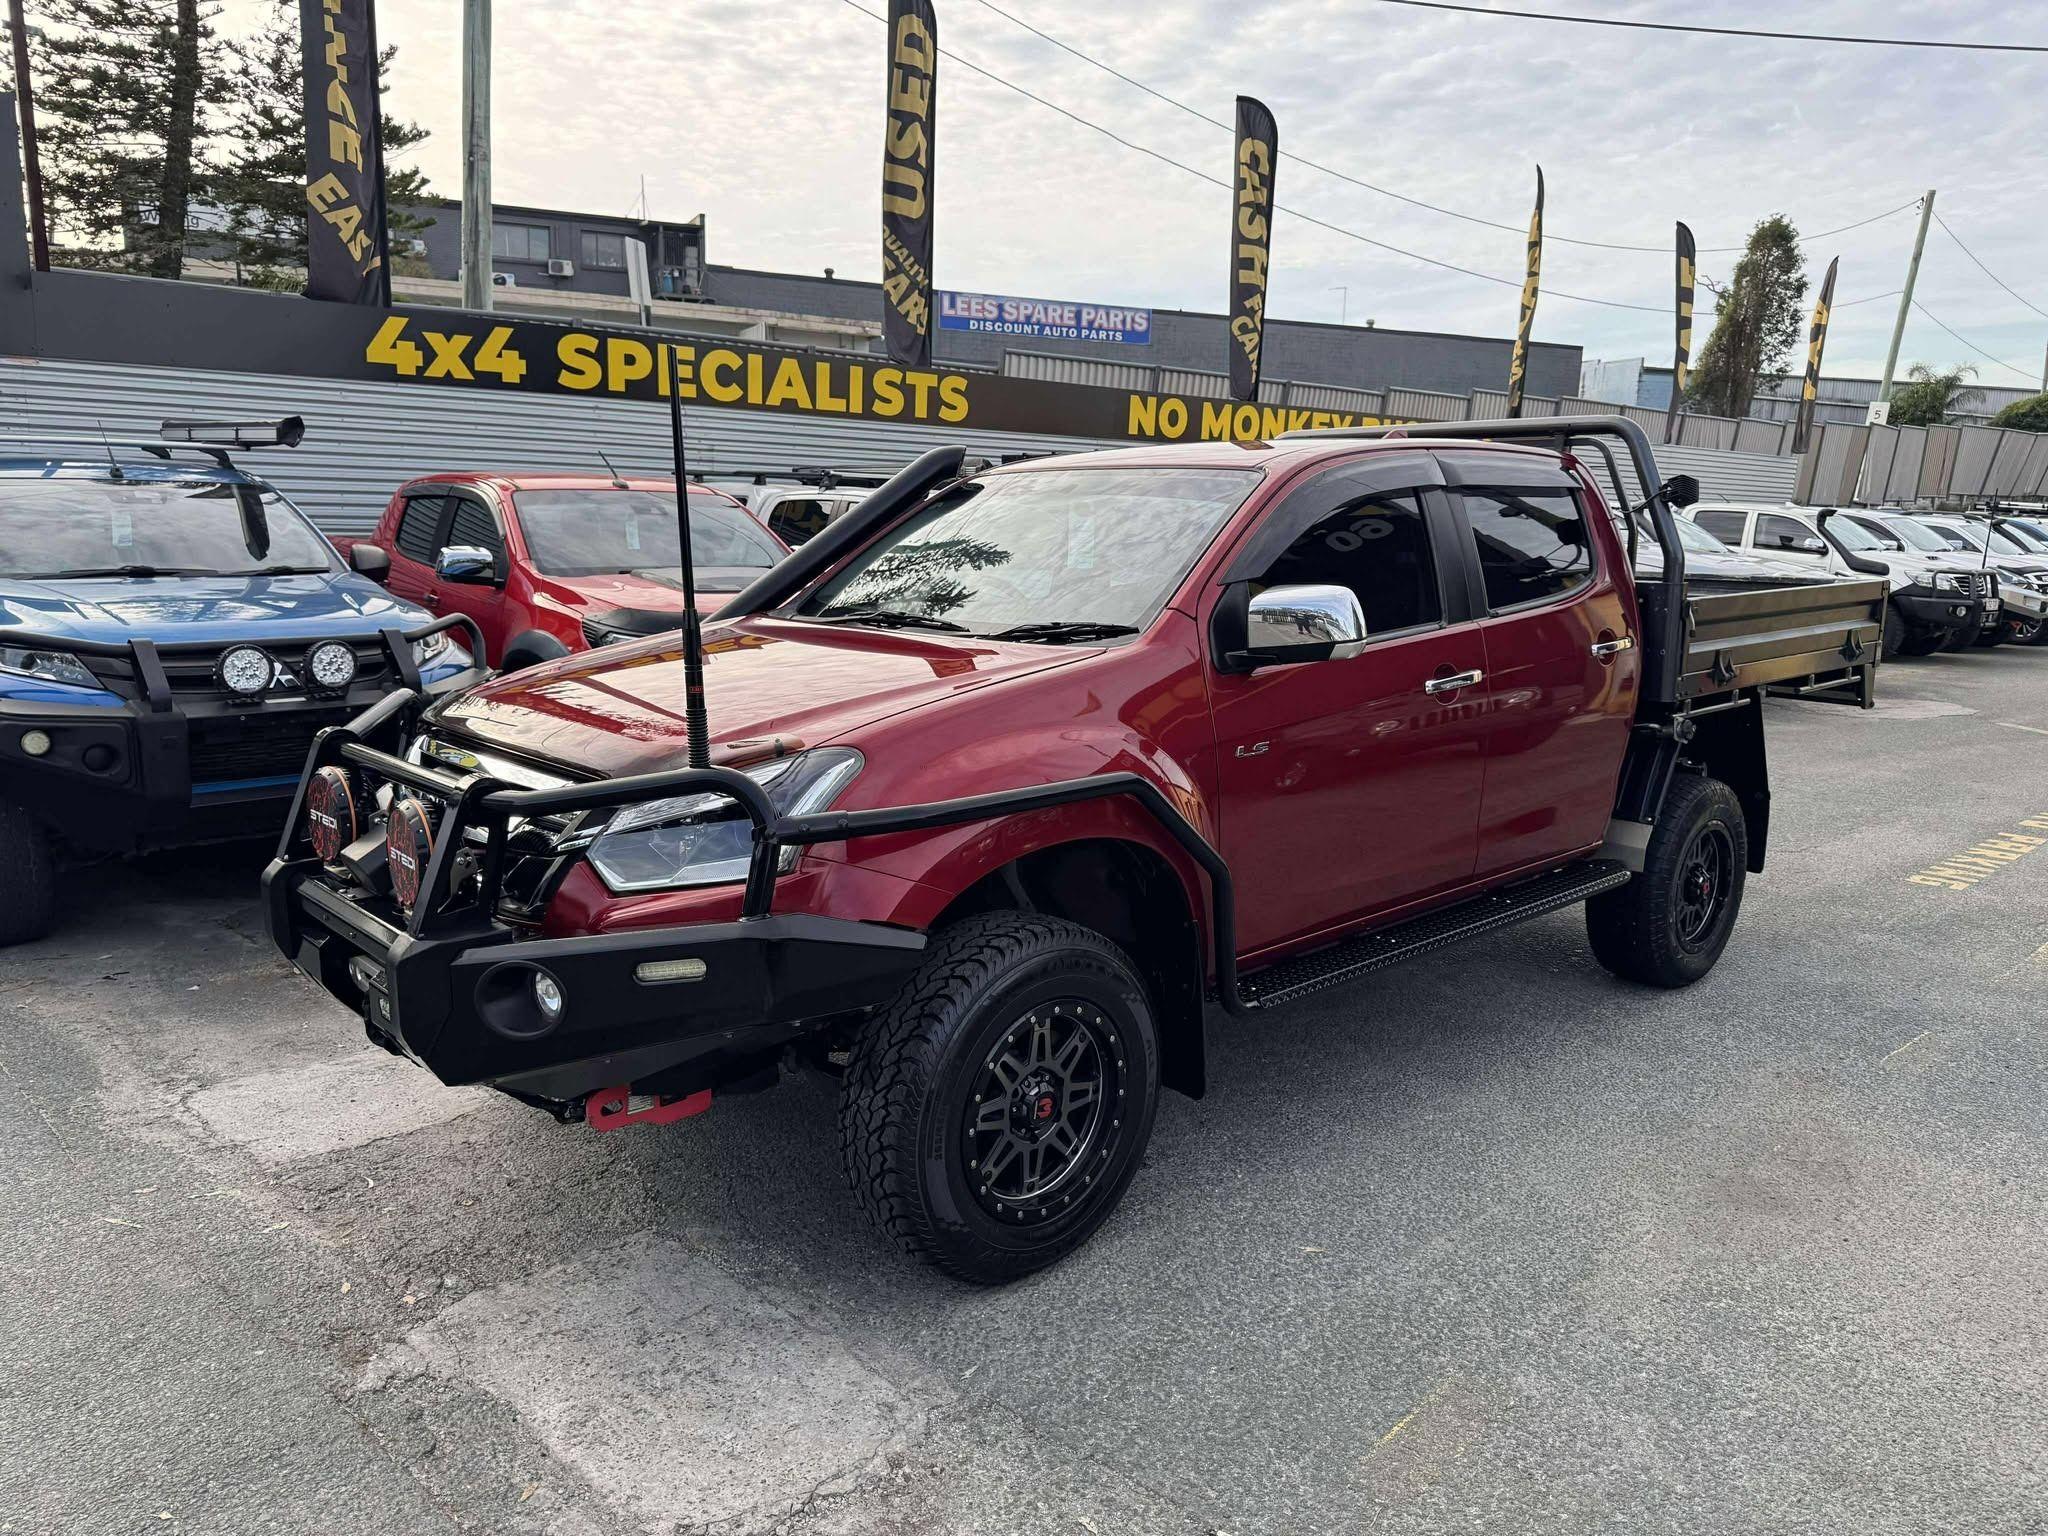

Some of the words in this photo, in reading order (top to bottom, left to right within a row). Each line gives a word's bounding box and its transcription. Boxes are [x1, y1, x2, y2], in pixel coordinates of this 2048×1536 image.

[884, 14, 933, 219] USED
[1238, 137, 1269, 291] CASH
[942, 293, 999, 320] LEES
[1003, 300, 1077, 327] SPARE
[1081, 308, 1149, 333] PARTS
[969, 320, 1039, 335] DISCOUNT
[1043, 325, 1078, 338] AUTO
[1081, 329, 1123, 341] PARTS
[366, 316, 527, 384] 4x4
[556, 333, 969, 423] SPECIALISTS
[1128, 395, 1188, 439] NO
[1874, 409, 1882, 420] 5
[1235, 741, 1270, 758] LS
